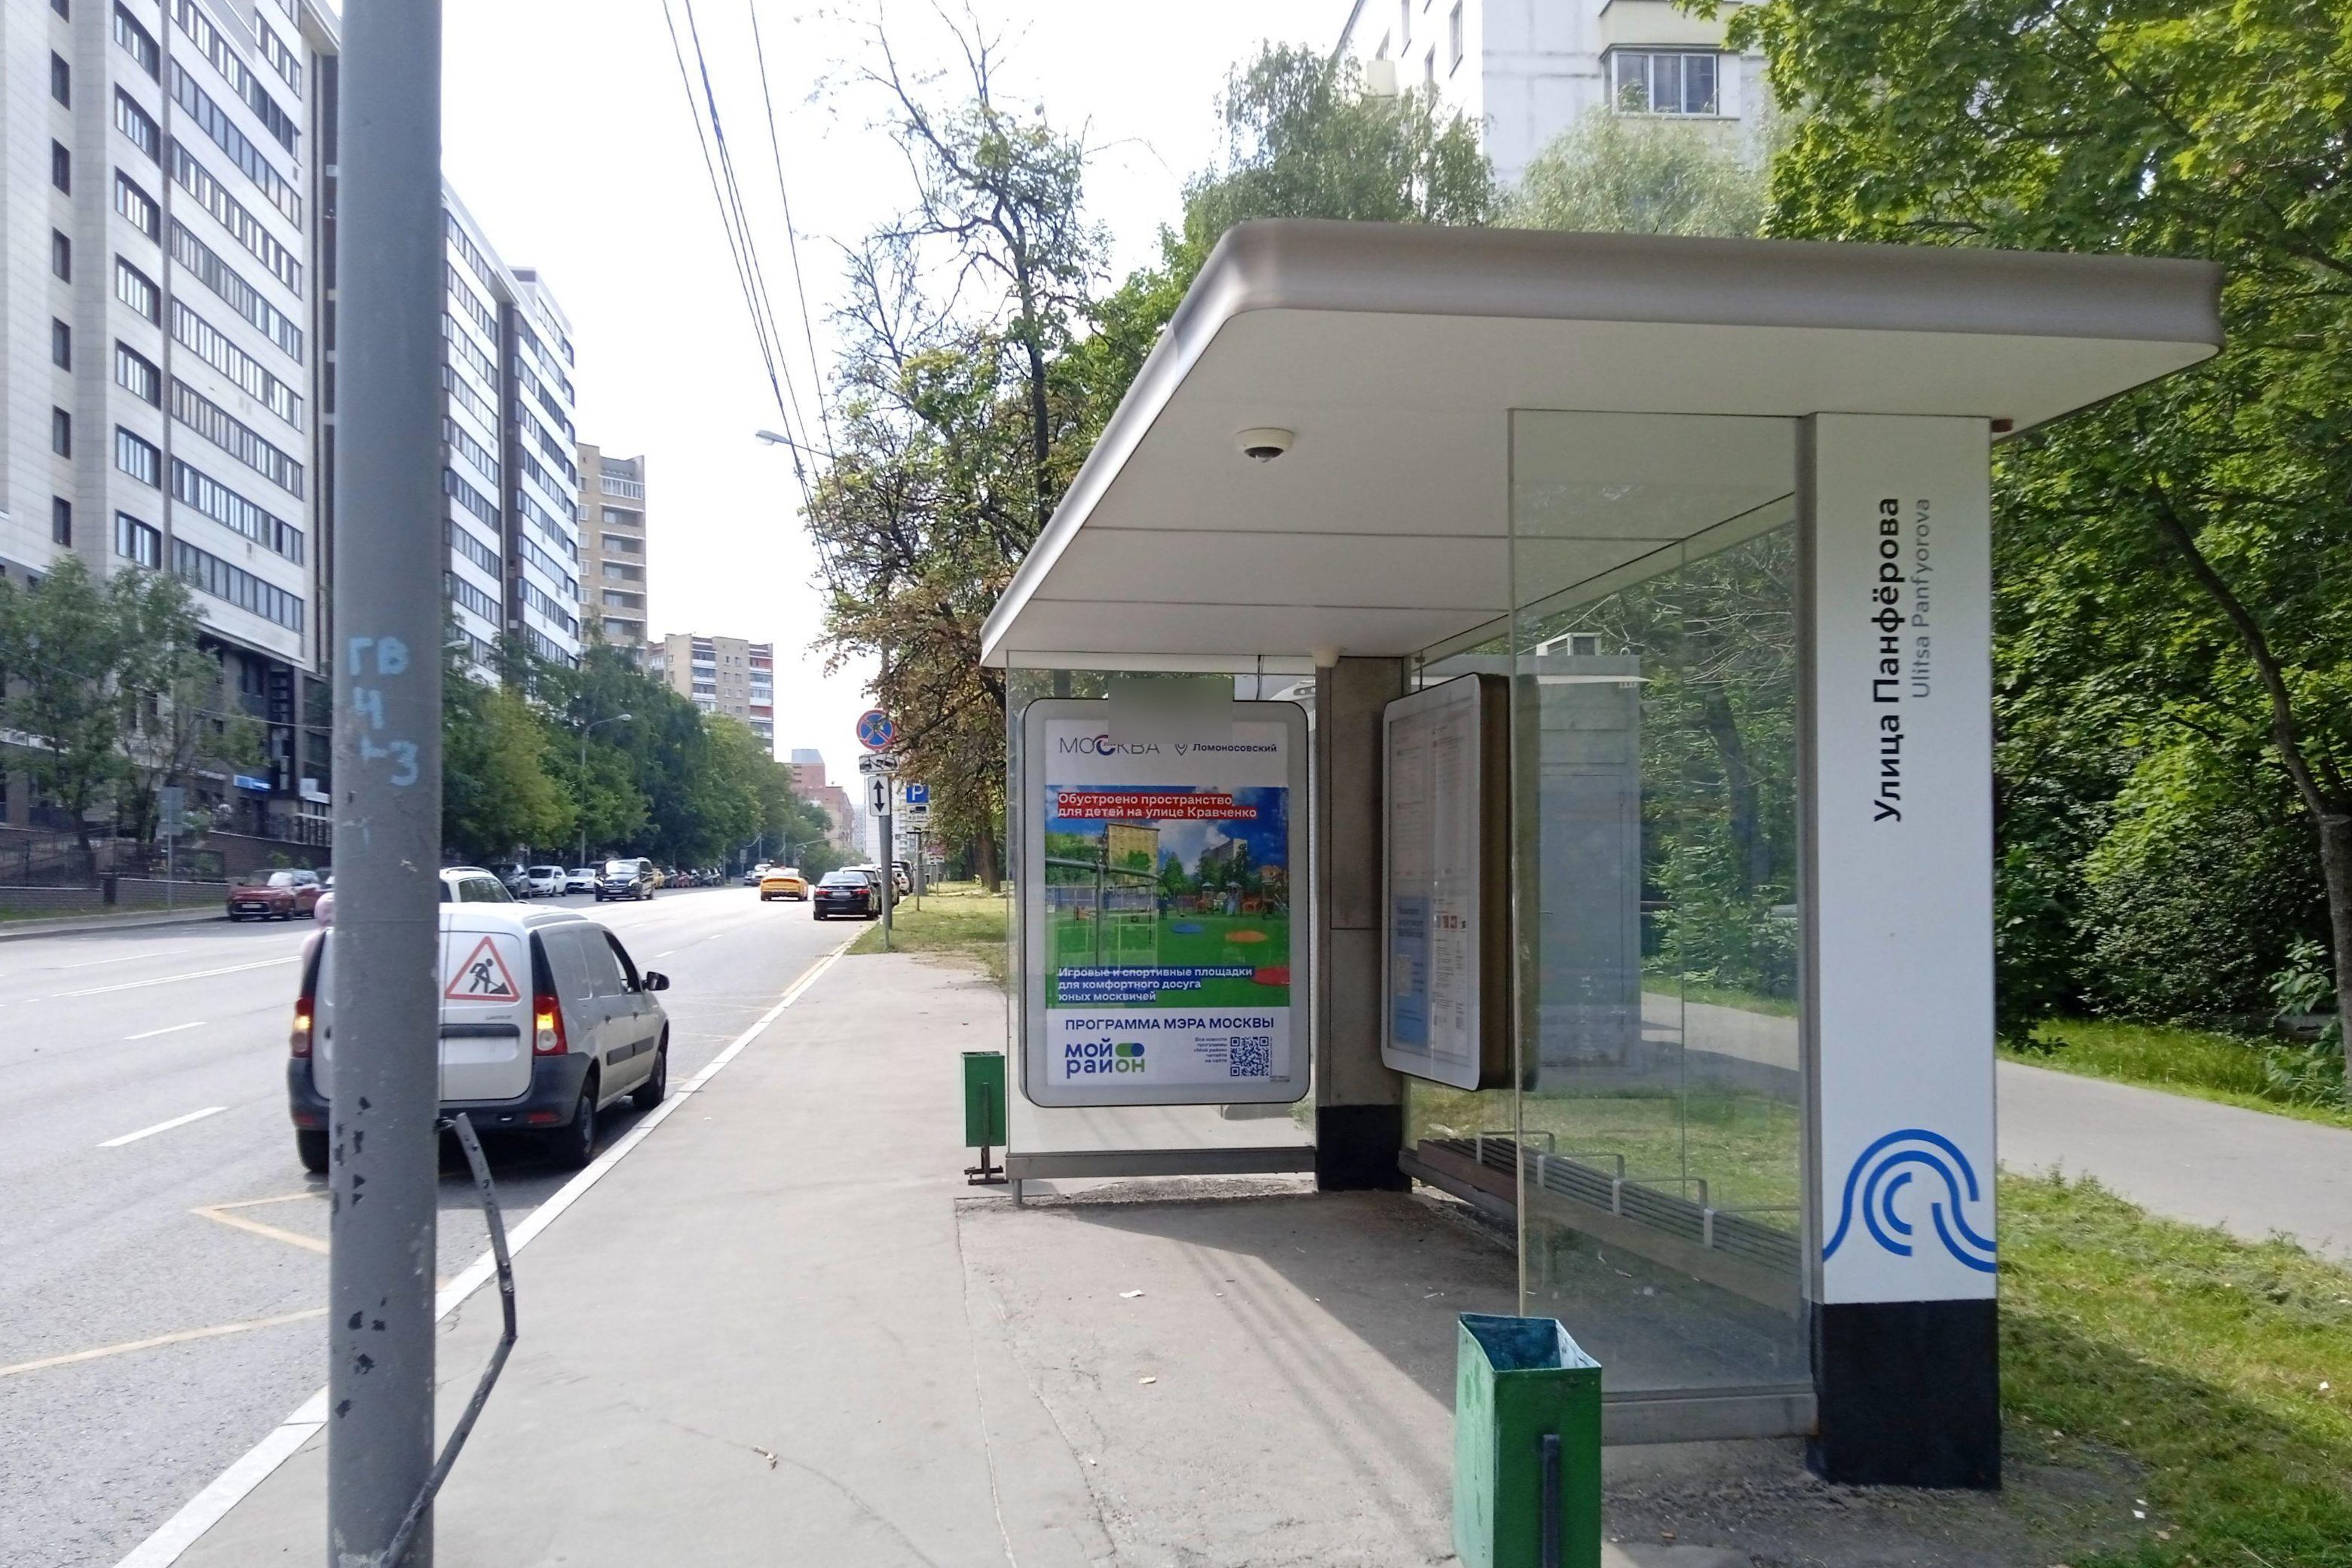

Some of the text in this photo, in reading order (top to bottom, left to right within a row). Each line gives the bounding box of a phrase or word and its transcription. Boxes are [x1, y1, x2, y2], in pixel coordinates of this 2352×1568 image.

[1909, 498, 1934, 698] Ulitsa Panfyorova
[1870, 498, 1906, 822] Улица Панфёрова
[1193, 743, 1278, 752] Ломоносовский
[912, 783, 924, 801] P
[1058, 793, 1233, 807] Обустроено пространство
[1058, 806, 1257, 820] для детей на улице Кравченко
[1058, 968, 1110, 978] Игровые
[1122, 969, 1193, 978] спортивные
[1194, 968, 1253, 978] площадки
[1058, 979, 1202, 991] для комфортного досуга
[1058, 990, 1156, 1002] юных москвичей
[1065, 1017, 1274, 1031] ПРОГРАММА МЭРА МОСКВЫ
[1064, 1037, 1113, 1058] мой
